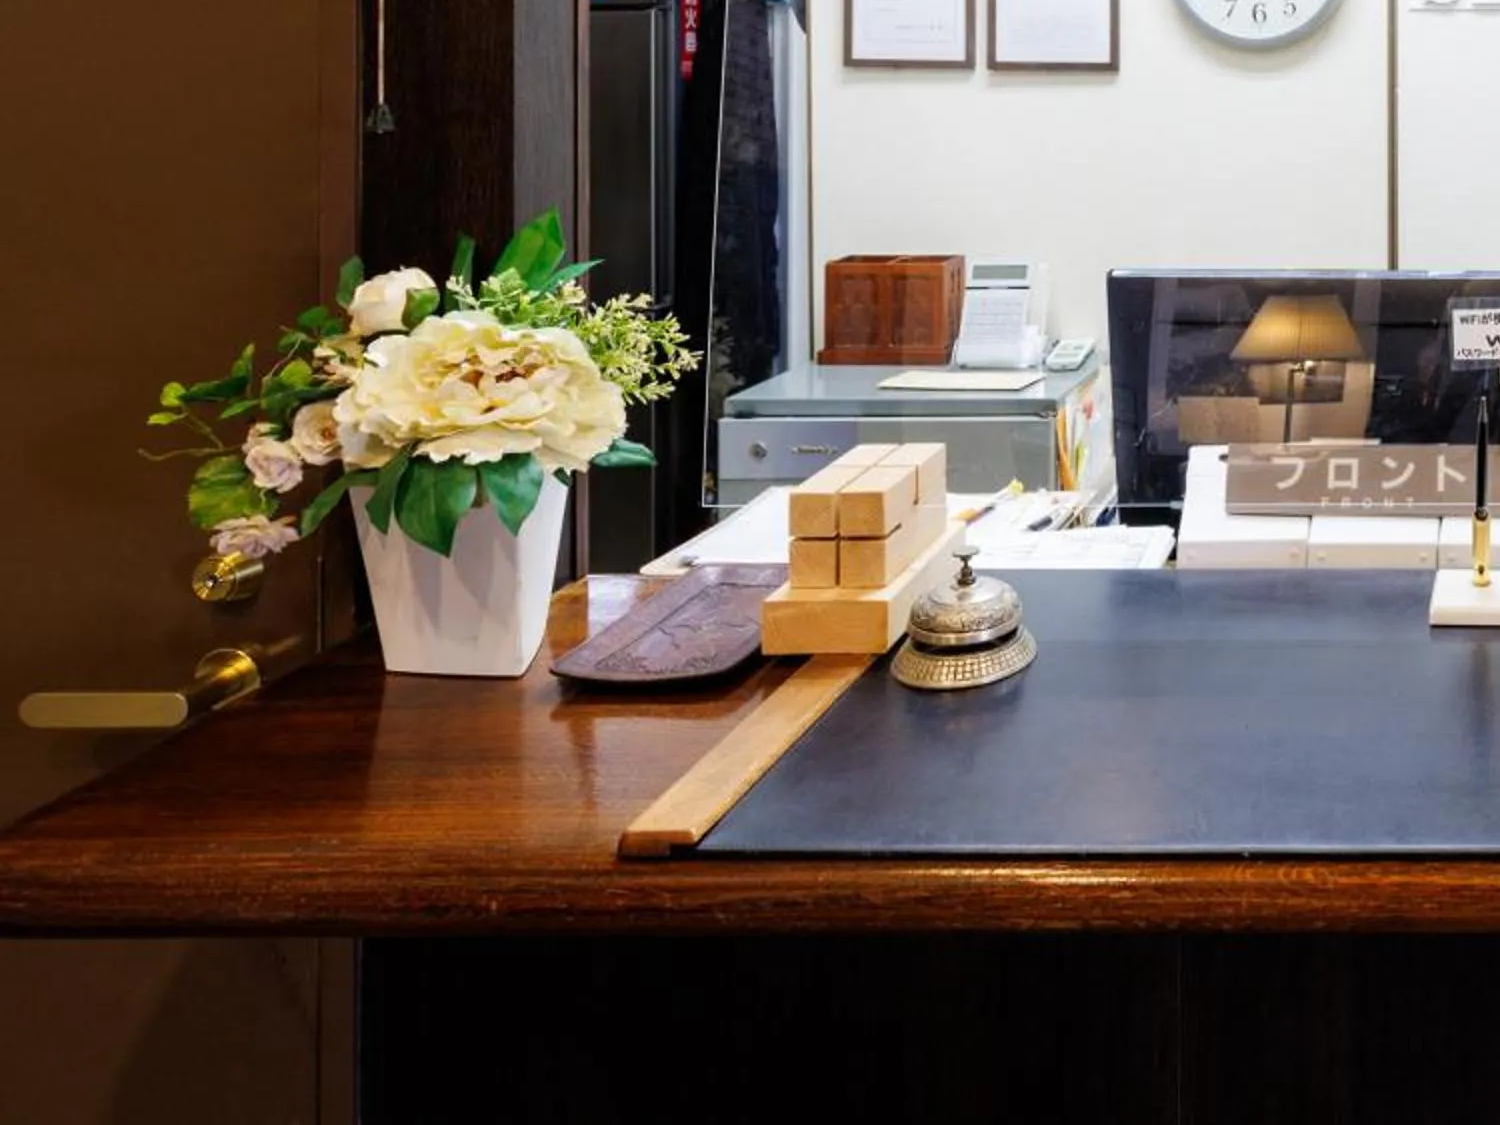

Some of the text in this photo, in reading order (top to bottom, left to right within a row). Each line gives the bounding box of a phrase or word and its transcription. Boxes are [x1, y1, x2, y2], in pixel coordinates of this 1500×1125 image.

[1252, 3, 1267, 23] 6
[1270, 453, 1467, 493] フロント
[1320, 496, 1415, 508] FRONT
